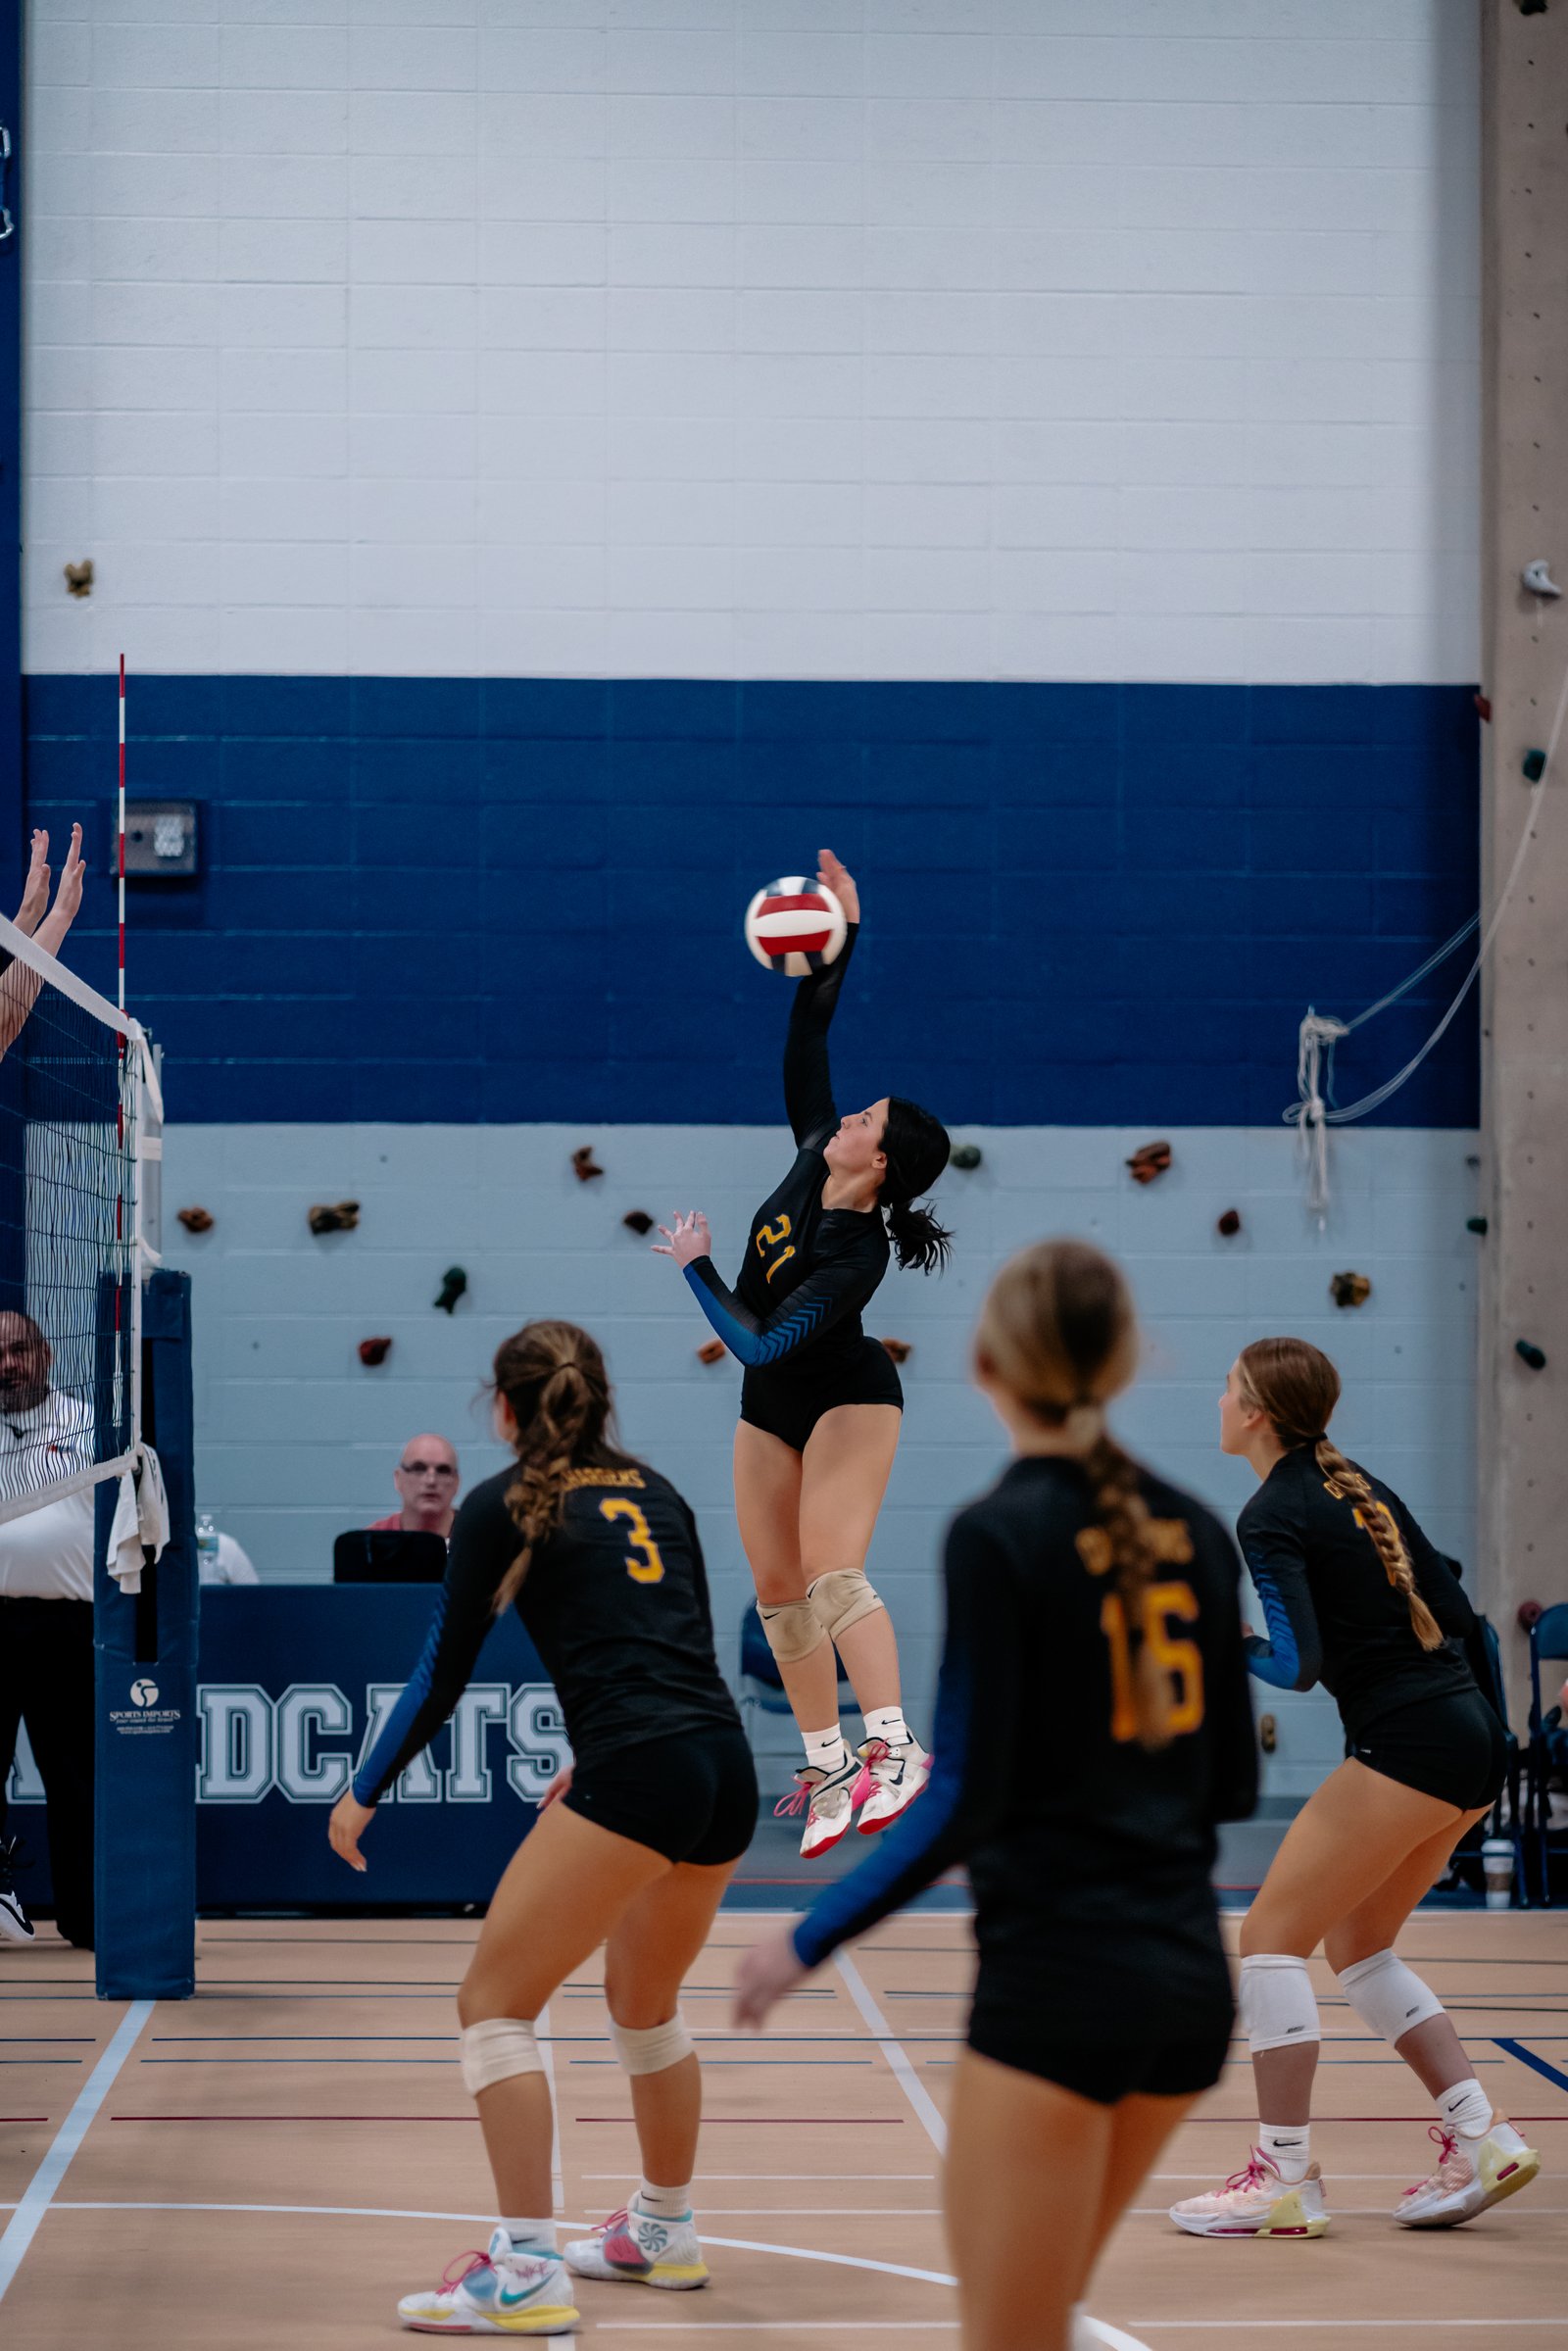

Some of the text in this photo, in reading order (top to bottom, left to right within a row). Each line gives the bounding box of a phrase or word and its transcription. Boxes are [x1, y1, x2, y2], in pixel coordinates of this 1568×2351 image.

[756, 1213, 797, 1285] 21
[599, 1497, 666, 1585] 3
[1100, 1579, 1206, 1743] 16
[110, 1710, 142, 1722] SPORTS
[143, 1709, 181, 1720] IMPORTS
